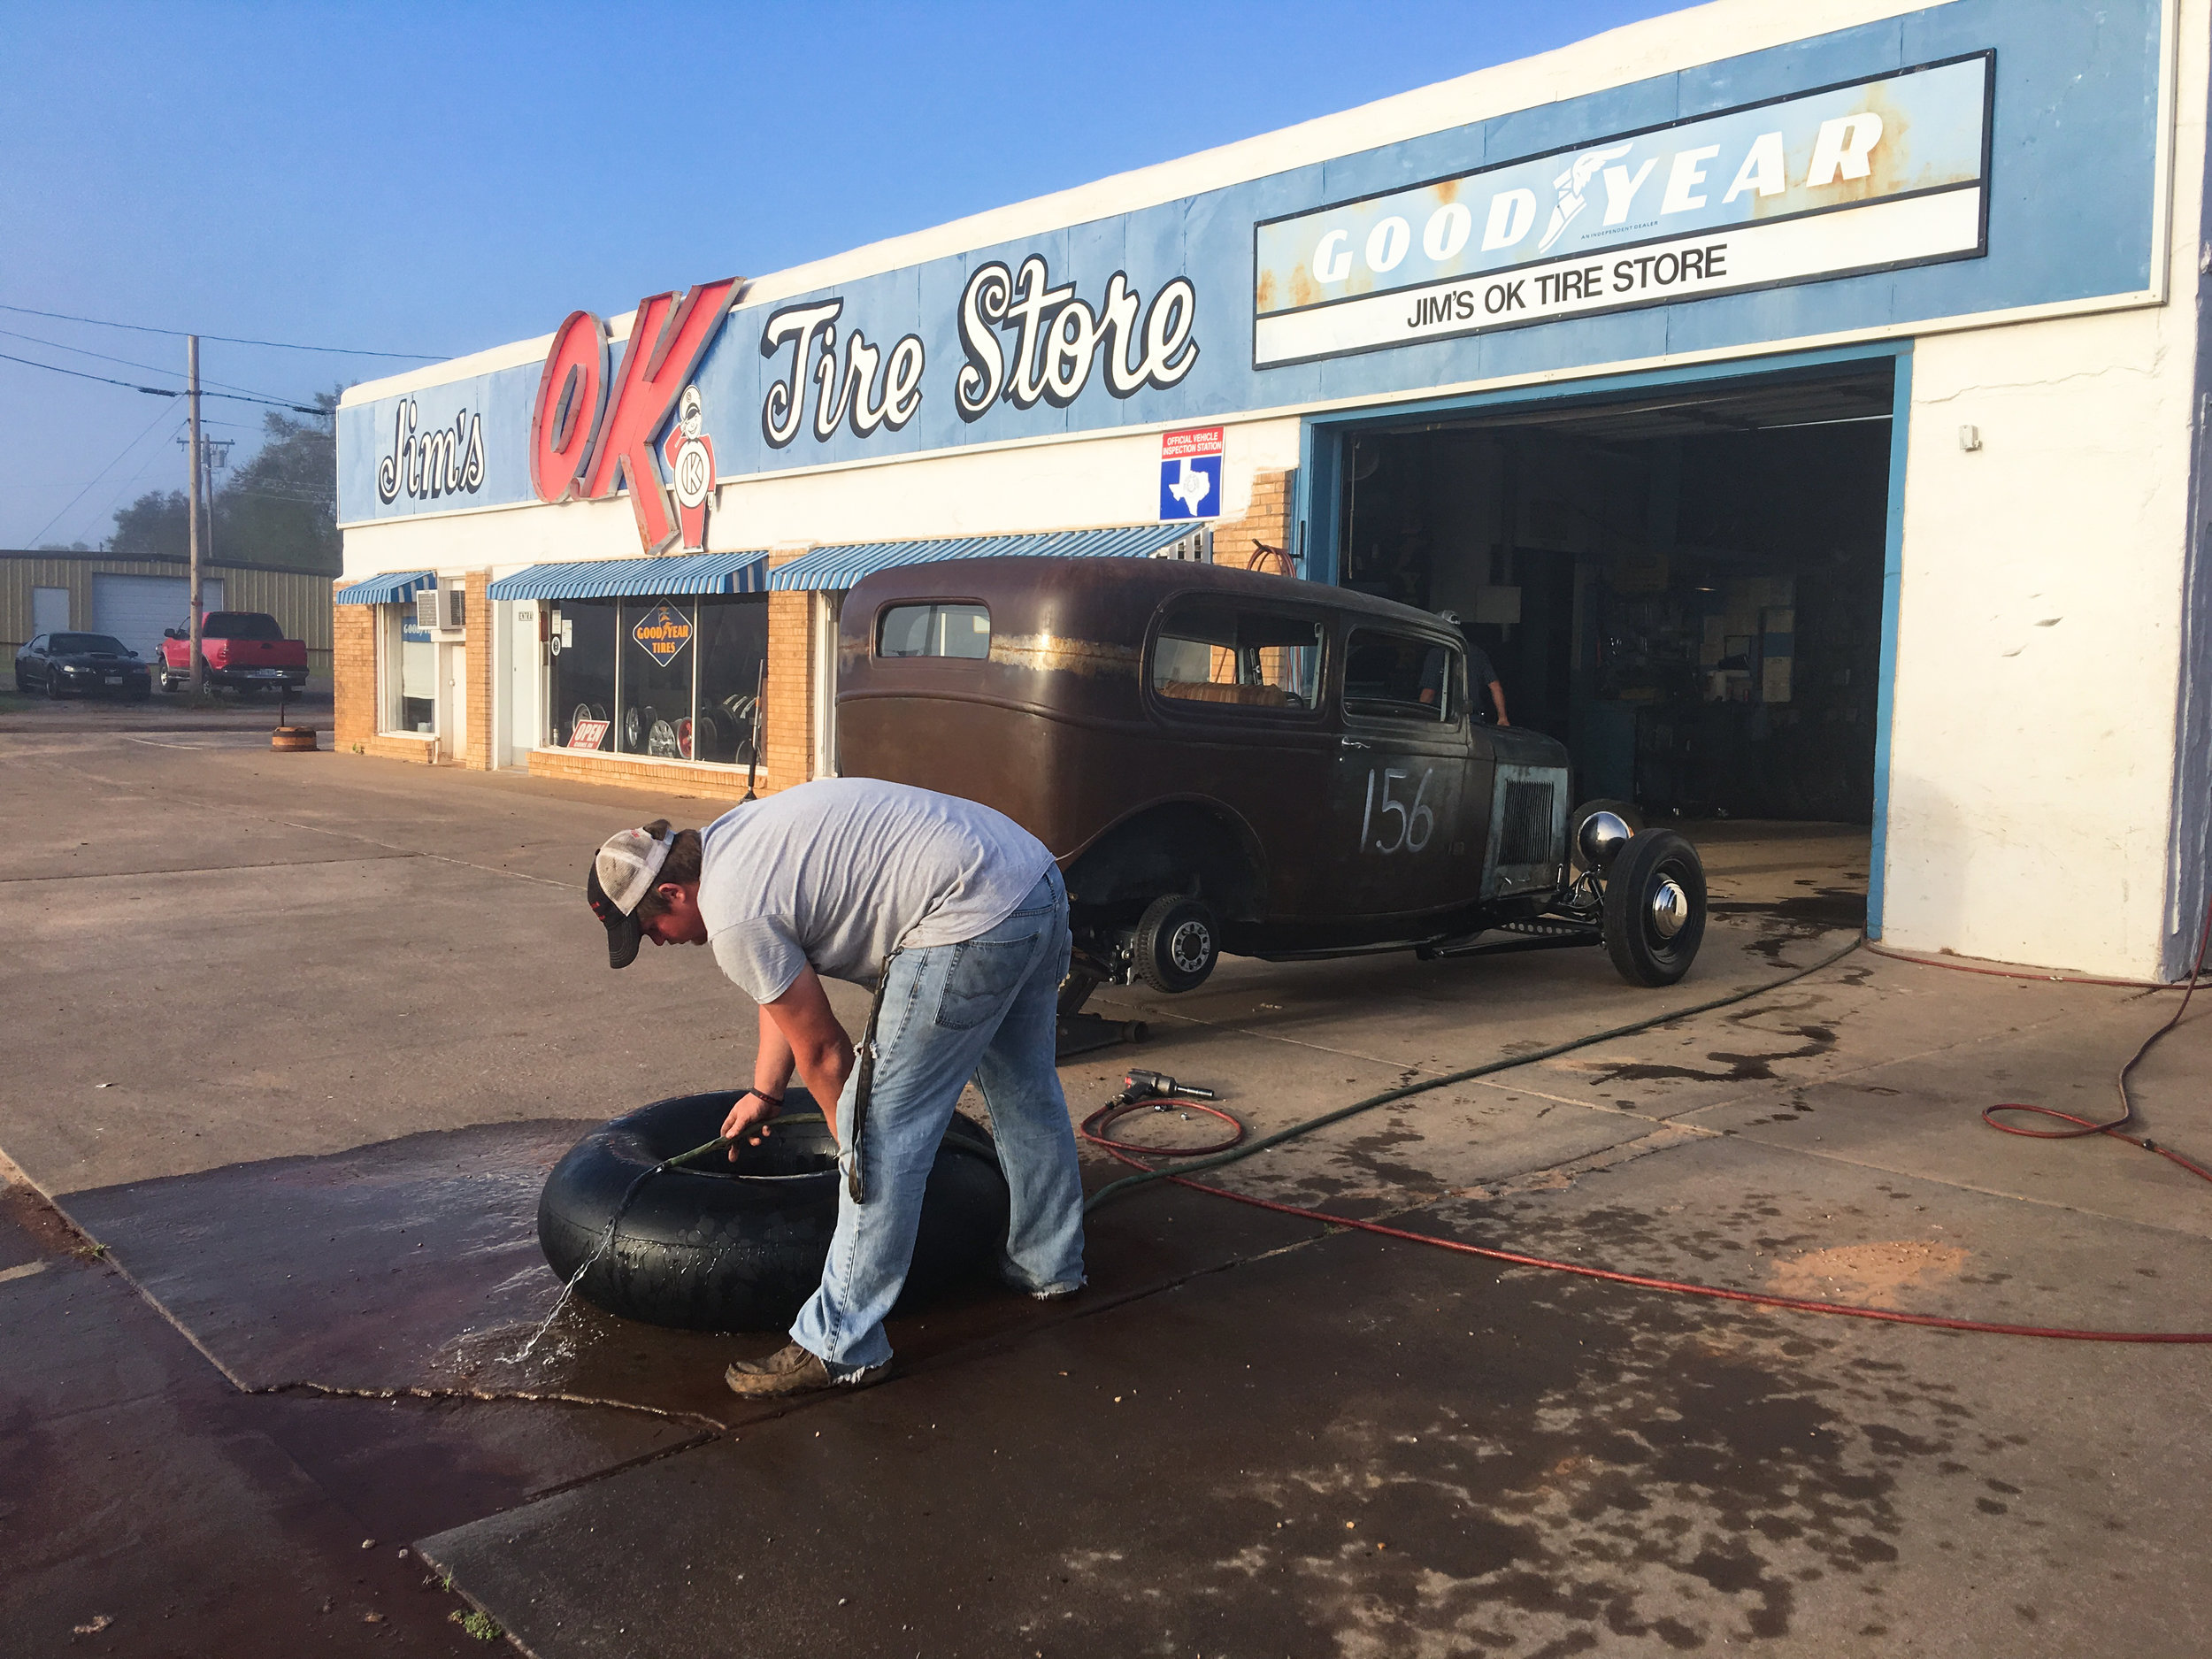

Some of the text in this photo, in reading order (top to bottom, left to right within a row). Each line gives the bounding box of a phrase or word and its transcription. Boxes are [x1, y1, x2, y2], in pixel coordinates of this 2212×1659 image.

[1311, 111, 1884, 284] GOODYEAR
[1590, 225, 1632, 238] INDEPENDENT
[1633, 220, 1659, 230] DEALER
[1407, 243, 1728, 328] JIM'S OK TIRE STORE
[378, 252, 1201, 556] Jim's OK Tire Store
[1166, 431, 1218, 446] OFFICIAL VEHICLE
[1163, 441, 1222, 456] INSPECTION STATION
[637, 624, 689, 640] GOODYEAR
[652, 641, 676, 654] TIRES
[574, 723, 605, 742] OPEN
[1359, 768, 1433, 854] 156
